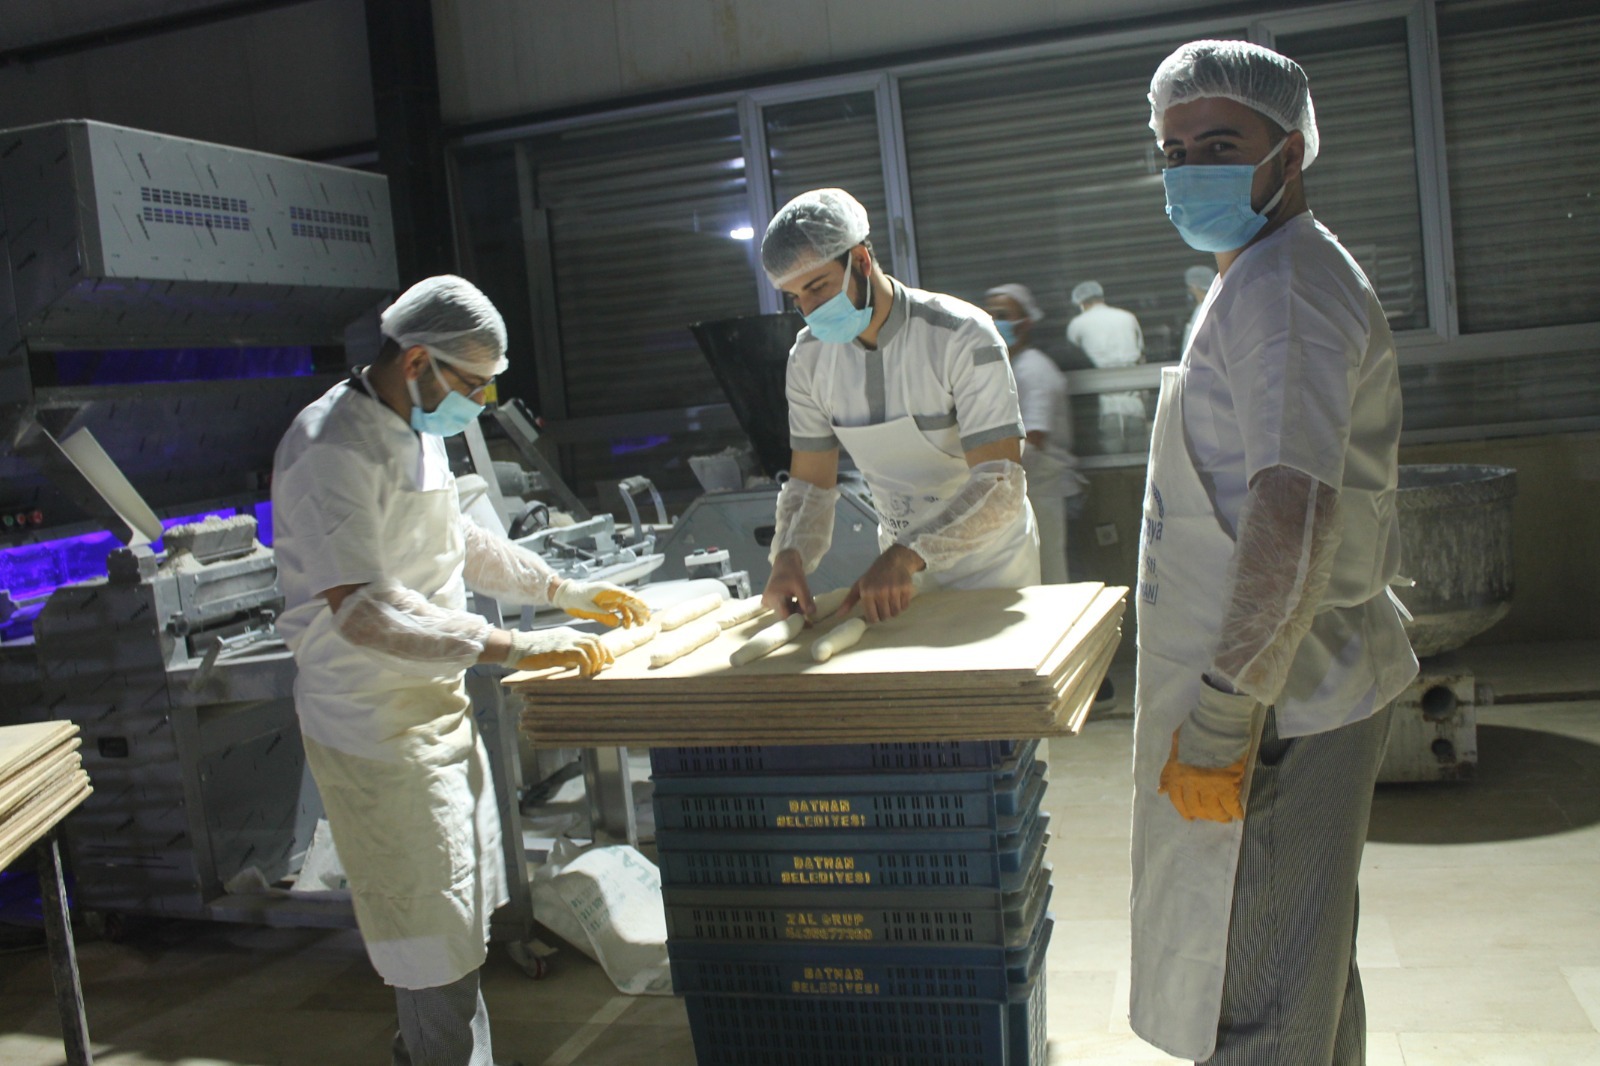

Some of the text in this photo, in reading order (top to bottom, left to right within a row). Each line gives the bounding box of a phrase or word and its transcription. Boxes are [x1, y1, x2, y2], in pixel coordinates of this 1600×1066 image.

[788, 799, 851, 813] BATMAN
[793, 856, 854, 870] BATMAN
[804, 967, 864, 981] BATMAN
